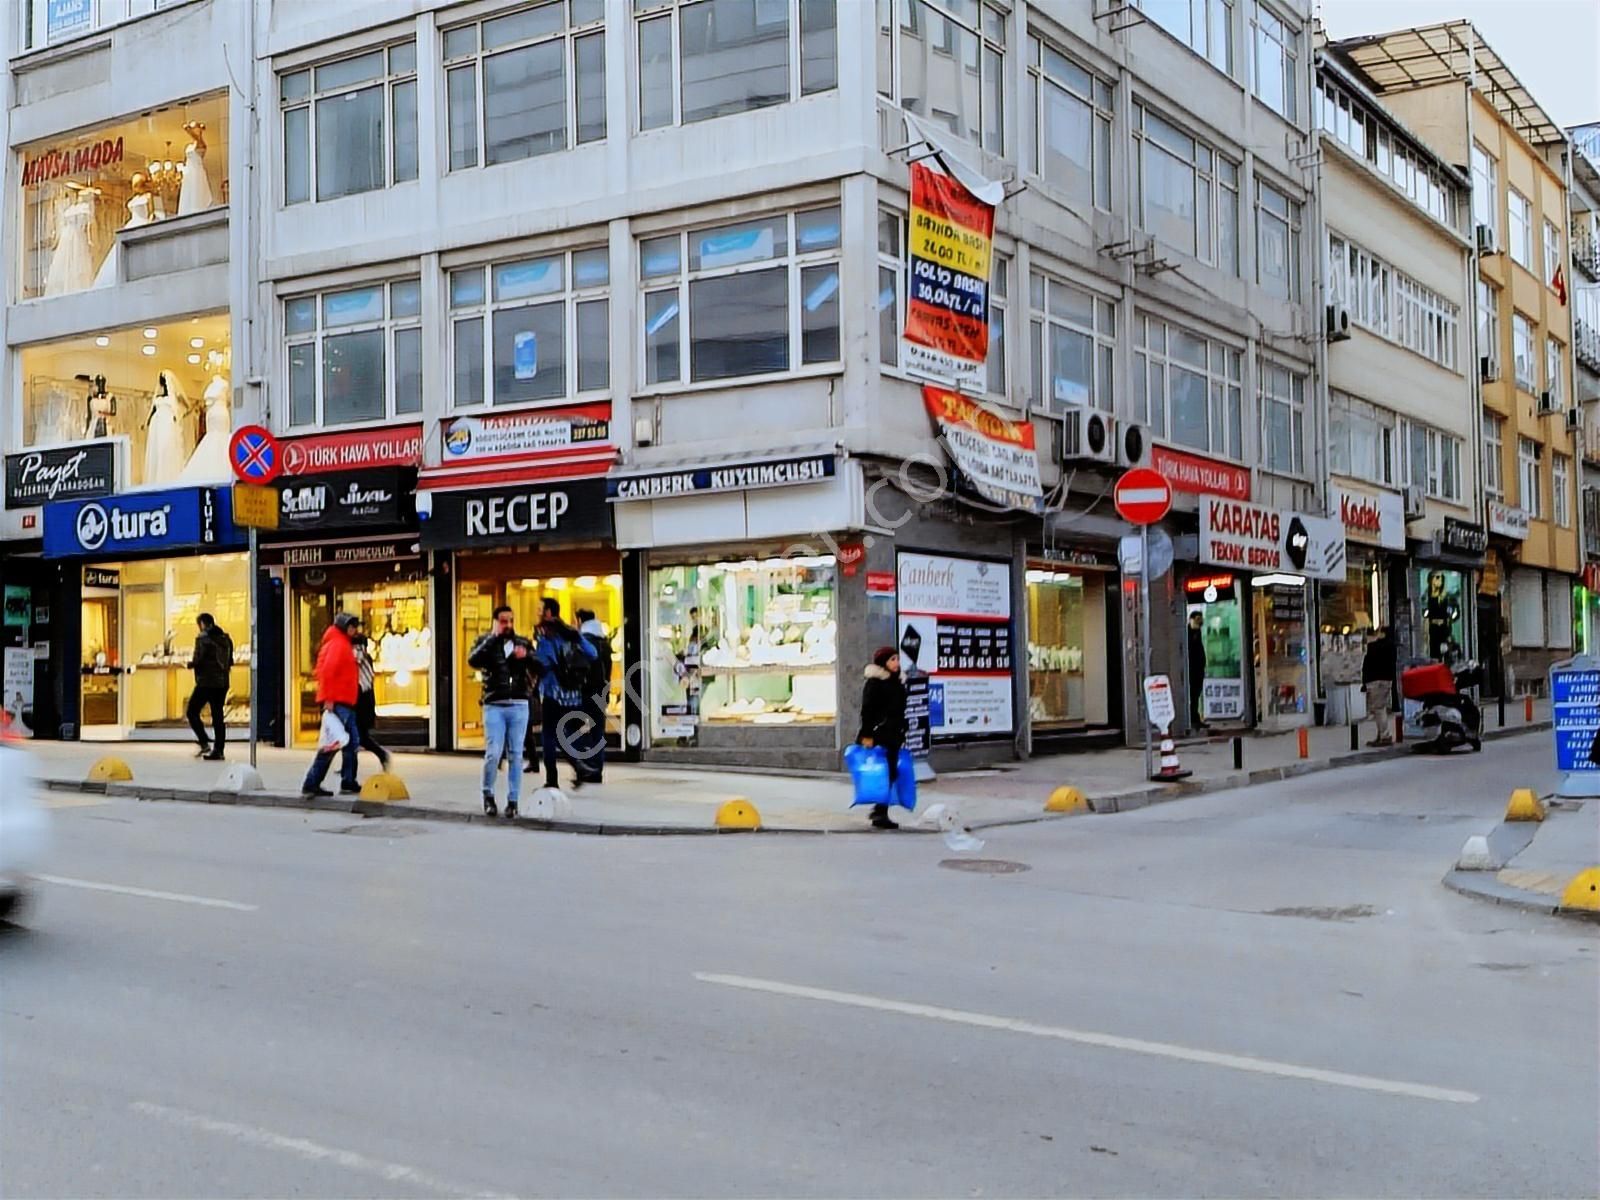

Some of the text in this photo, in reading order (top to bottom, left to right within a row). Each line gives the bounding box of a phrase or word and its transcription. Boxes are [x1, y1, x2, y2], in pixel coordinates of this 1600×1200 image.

[74, 136, 124, 173] MODA
[308, 437, 423, 467] TÜRK HAVA YOLLARI
[20, 450, 87, 499] Payet
[617, 459, 824, 498] CANBERK KUYUMCUSU
[111, 505, 170, 540] tura
[466, 491, 569, 537] RECEP
[1209, 500, 1280, 545] KARATAŞ
